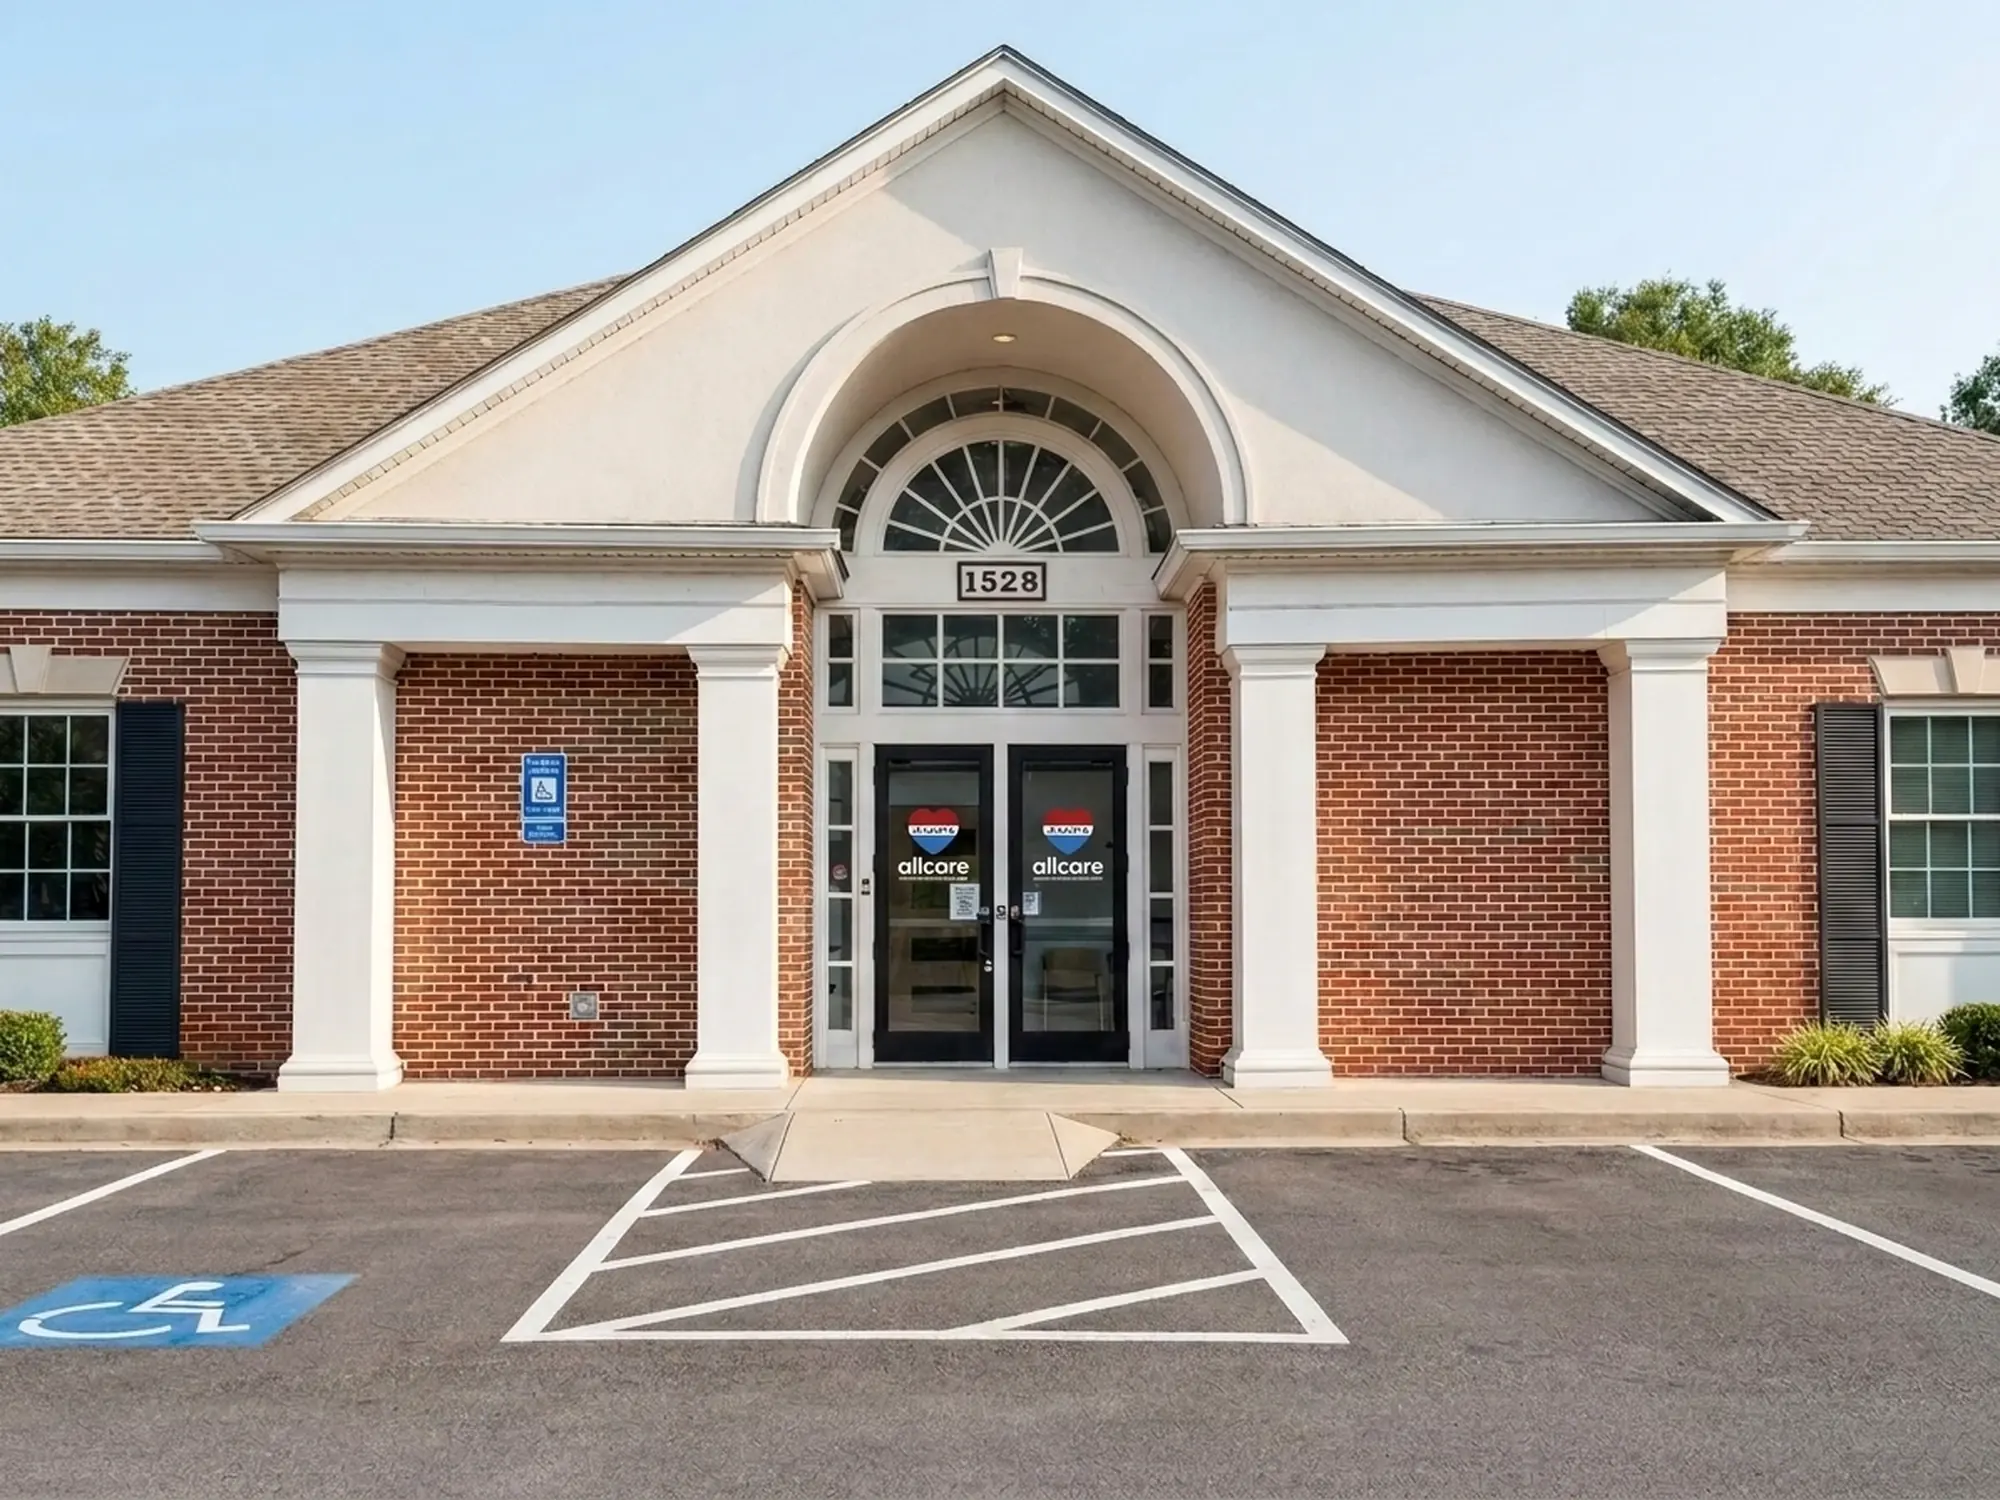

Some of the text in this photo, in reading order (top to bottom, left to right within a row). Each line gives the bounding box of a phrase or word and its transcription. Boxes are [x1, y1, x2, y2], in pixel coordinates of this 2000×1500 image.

[965, 571, 1038, 592] 1528
[898, 857, 970, 875] allcare
[1032, 857, 1104, 875] allcare
